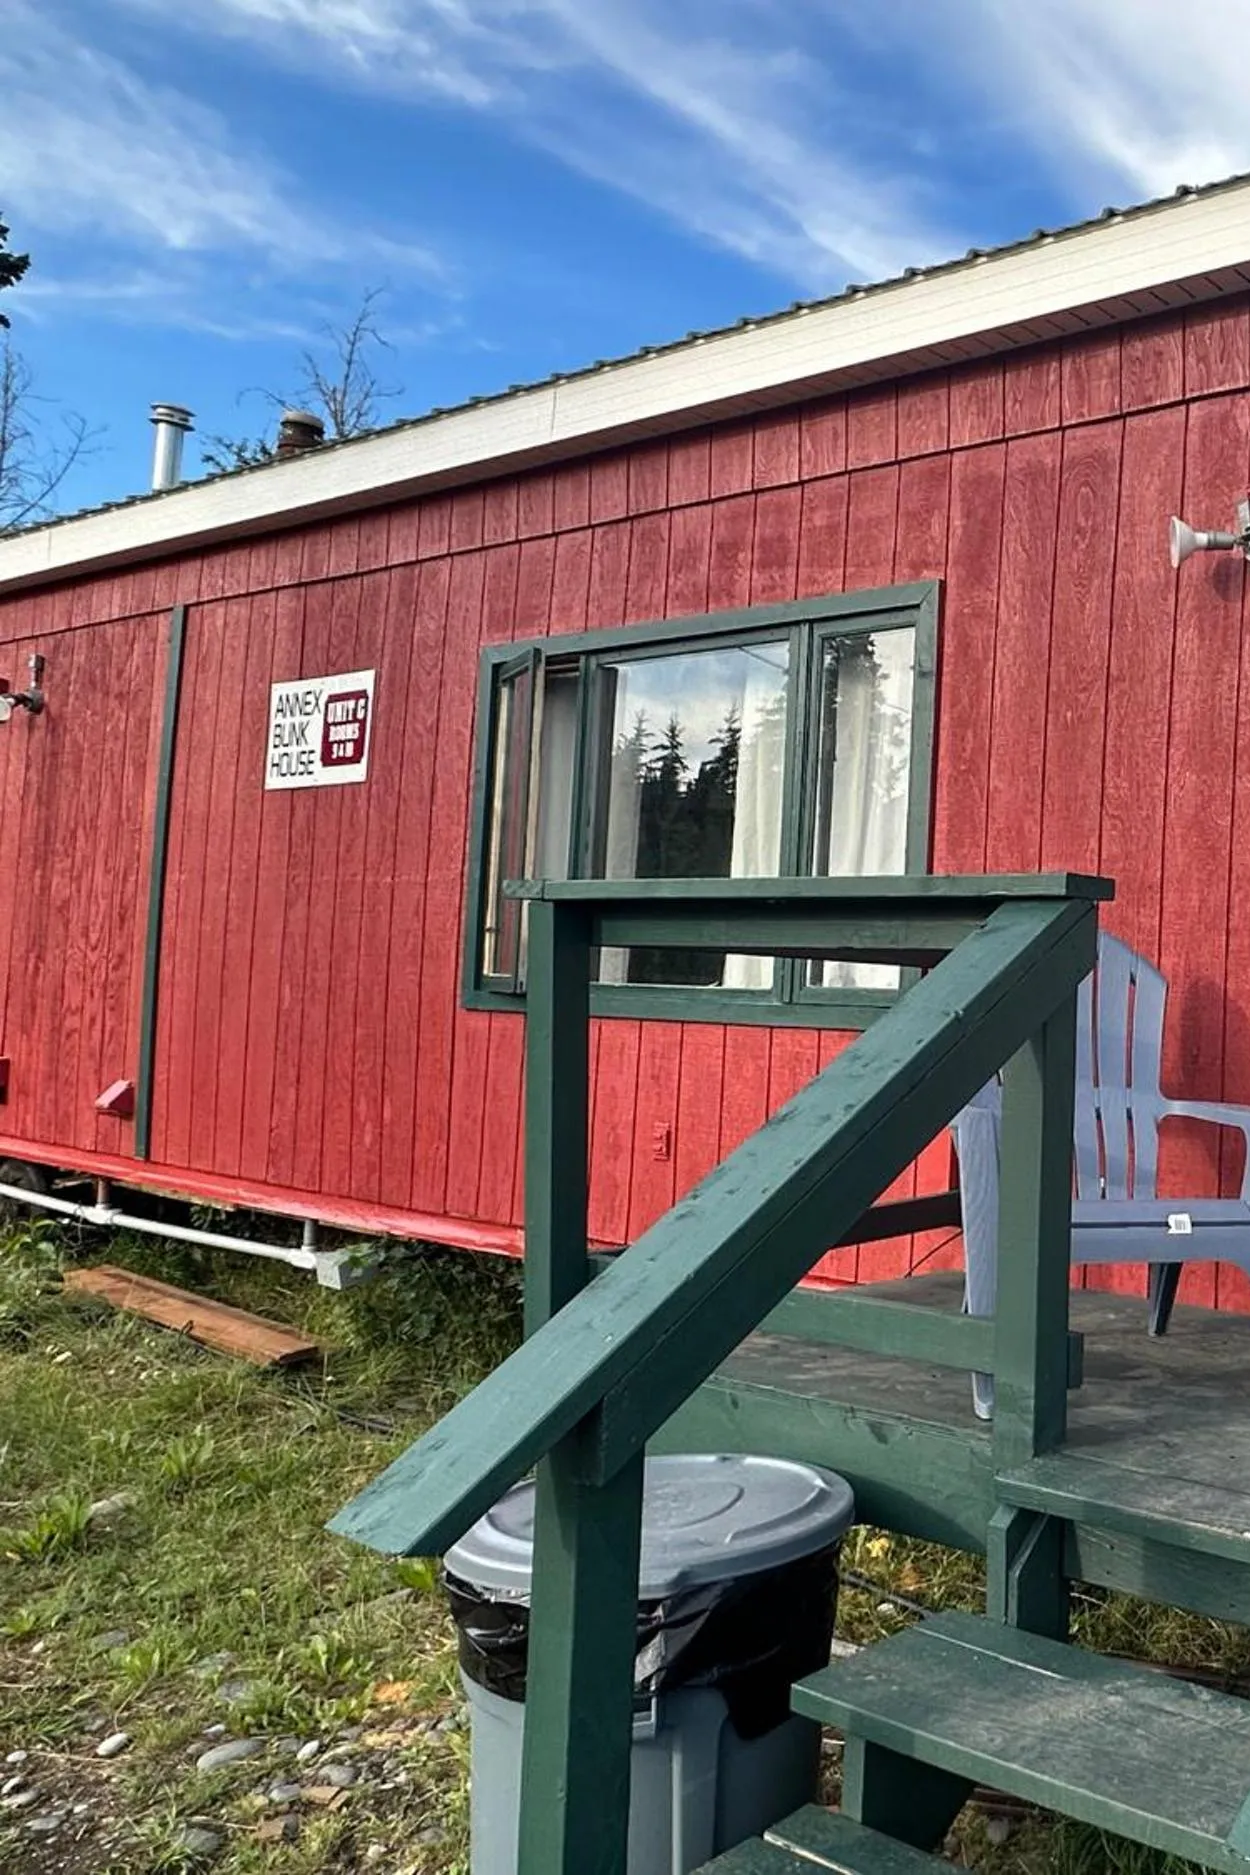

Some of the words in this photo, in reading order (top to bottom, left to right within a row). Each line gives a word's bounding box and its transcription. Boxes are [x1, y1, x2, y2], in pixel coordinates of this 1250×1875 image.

[274, 688, 324, 720] ANNEX
[272, 720, 311, 749] BUNK
[270, 749, 316, 778] HOUSE
